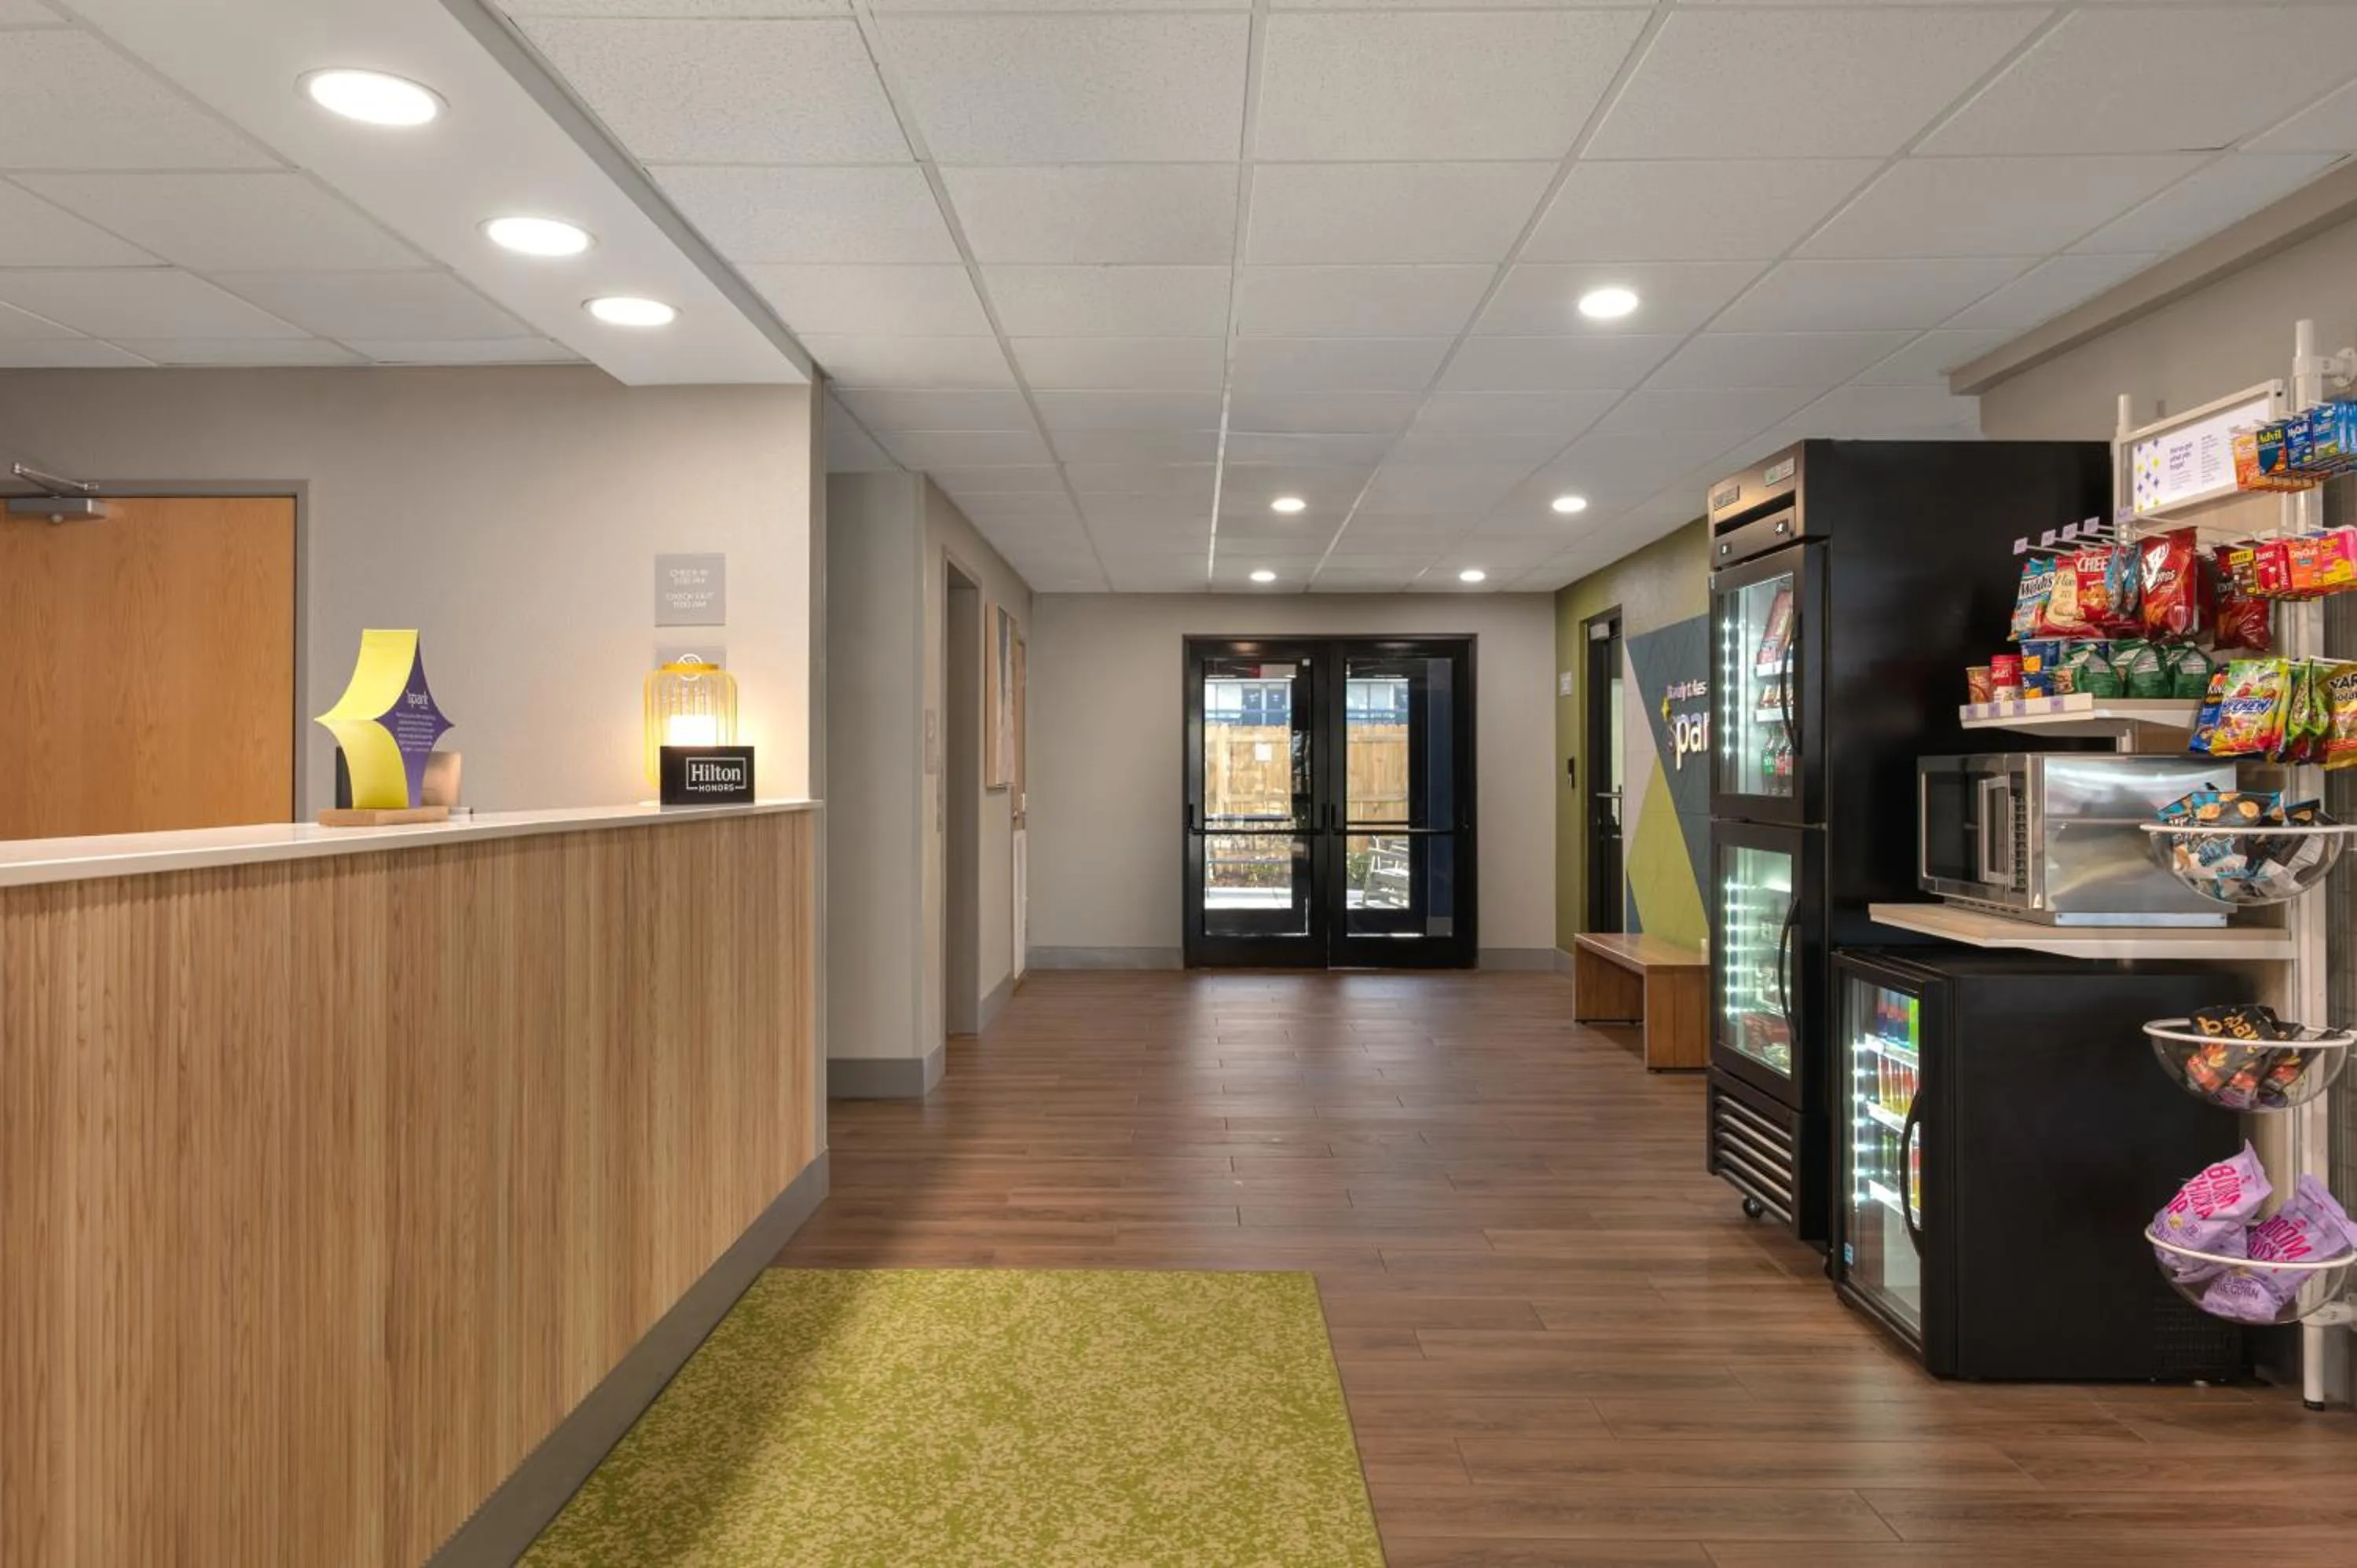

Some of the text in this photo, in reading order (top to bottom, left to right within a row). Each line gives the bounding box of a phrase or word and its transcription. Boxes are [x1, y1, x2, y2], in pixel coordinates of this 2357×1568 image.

[2259, 429, 2282, 443] Advil
[2077, 556, 2109, 572] CHEE
[691, 764, 741, 782] Hilton
[698, 784, 734, 793] HONORS
